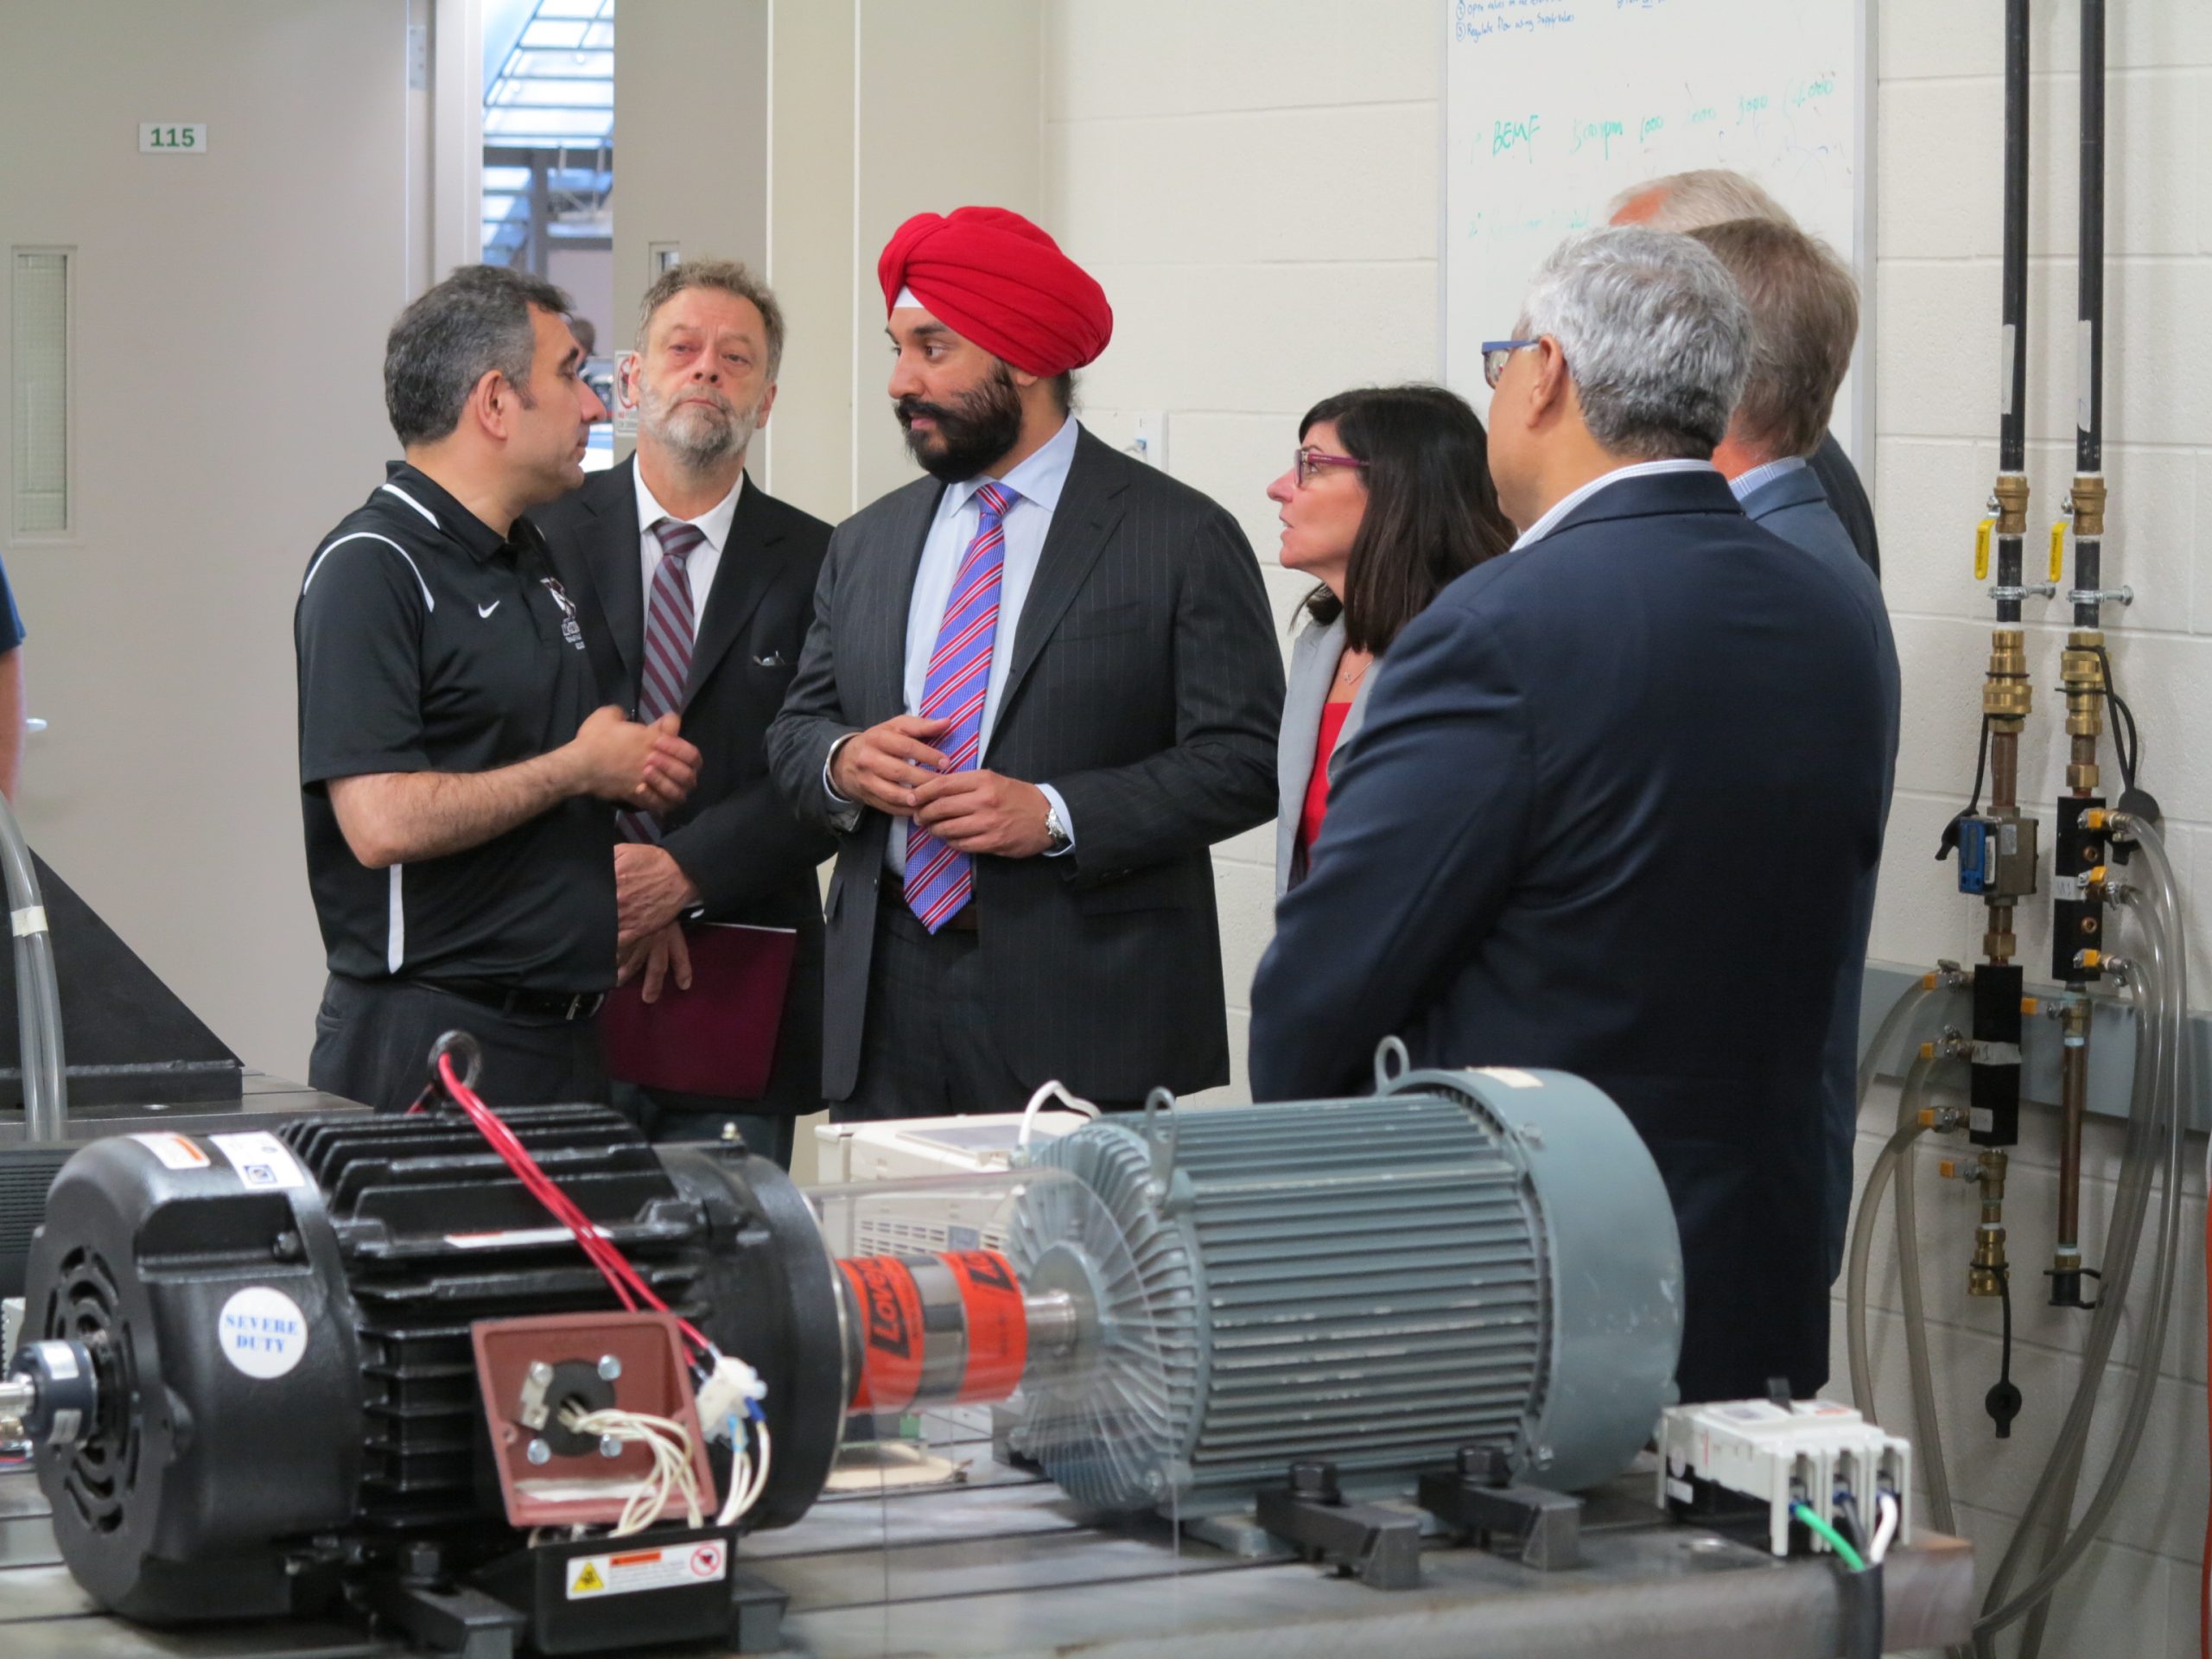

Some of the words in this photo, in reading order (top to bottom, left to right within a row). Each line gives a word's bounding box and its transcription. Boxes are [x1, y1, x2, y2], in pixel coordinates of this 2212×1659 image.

[150, 127, 195, 148] 115
[226, 1314, 298, 1335] SEVERE
[237, 1335, 284, 1354] DUTY
